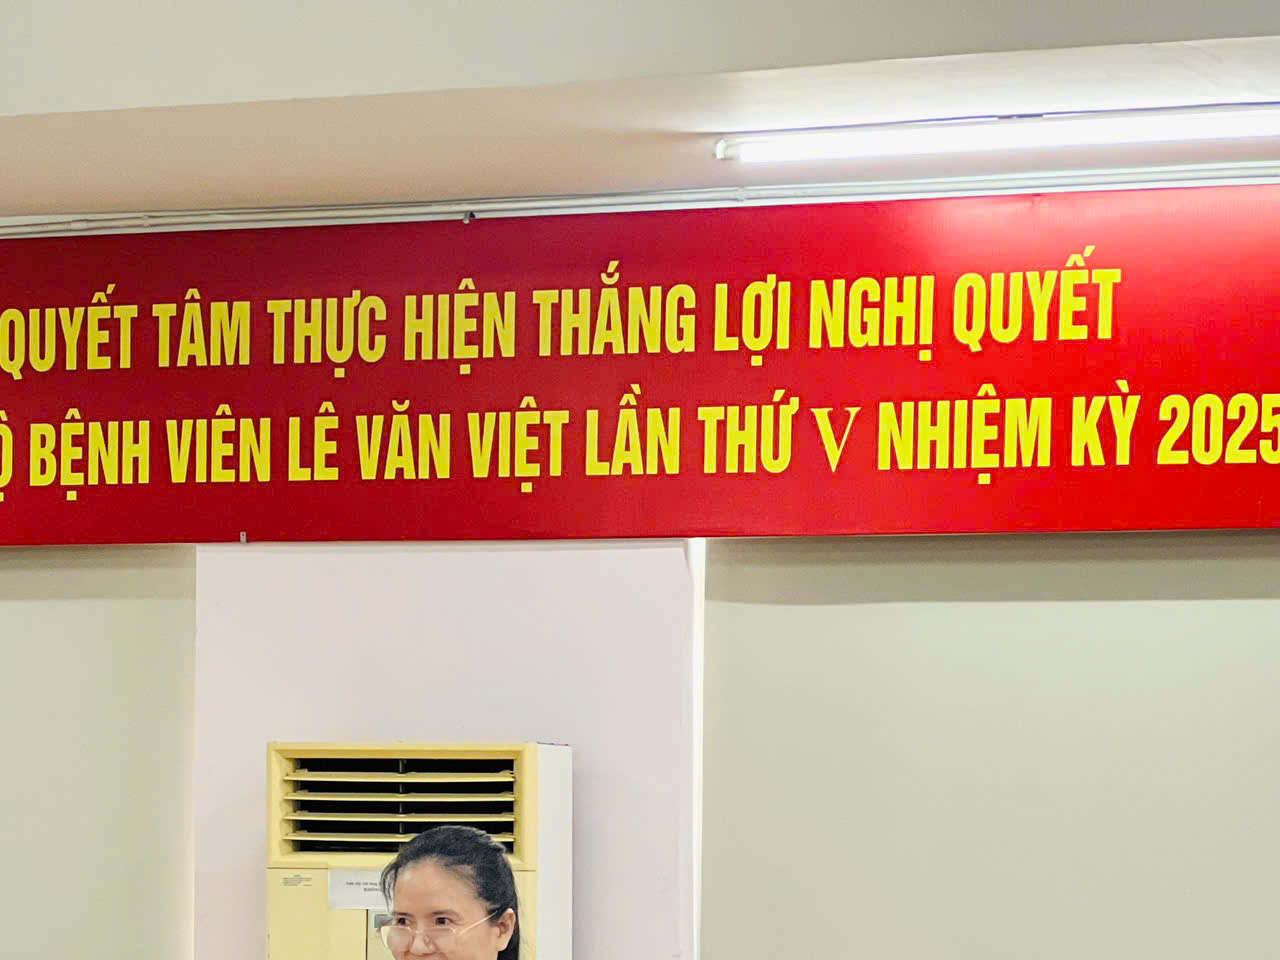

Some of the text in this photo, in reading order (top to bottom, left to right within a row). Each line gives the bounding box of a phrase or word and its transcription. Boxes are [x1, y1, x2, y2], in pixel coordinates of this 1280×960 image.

[152, 287, 251, 368] TÂM
[266, 290, 387, 379] THỰC
[404, 278, 516, 375] HIỆN
[532, 260, 697, 357] THẮNG
[713, 273, 792, 368] LỢI
[808, 275, 935, 362] NGHỊ
[952, 246, 1122, 353] QUYẾT
[29, 407, 151, 502] BỆNH
[166, 403, 271, 484] VIÊN
[287, 400, 340, 481] LÊ
[355, 399, 452, 480] VĂN
[466, 395, 570, 493] VIỆT
[585, 383, 682, 476] LẦN
[697, 389, 800, 474] THỨ
[811, 406, 860, 473] V
[877, 382, 1053, 485] NHIỆM
[1070, 378, 1142, 467] KỲ
[1156, 393, 1280, 465] 2025
